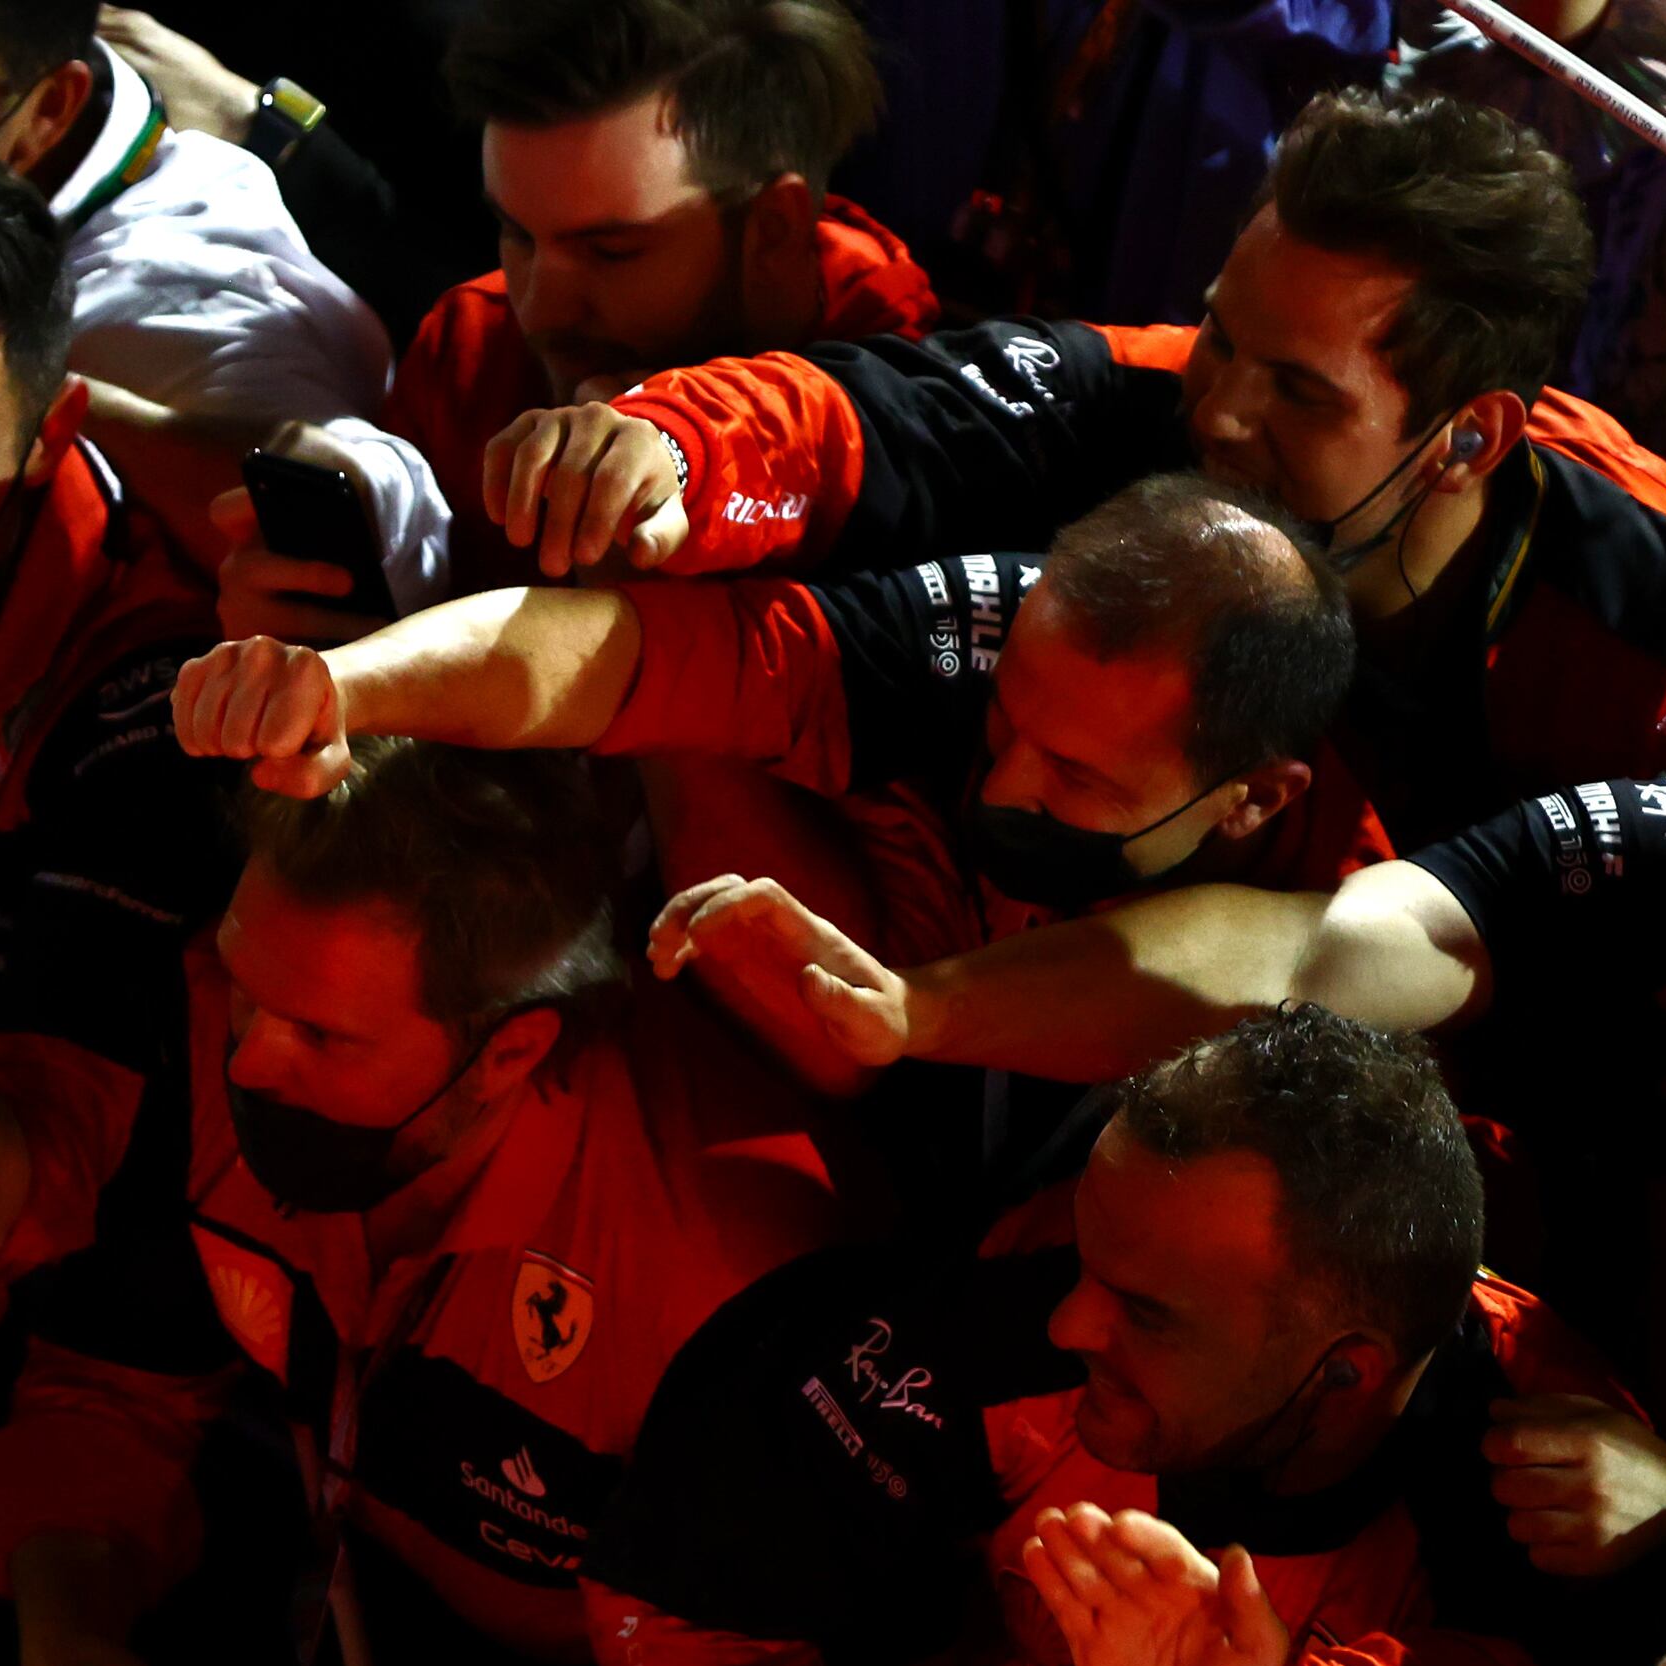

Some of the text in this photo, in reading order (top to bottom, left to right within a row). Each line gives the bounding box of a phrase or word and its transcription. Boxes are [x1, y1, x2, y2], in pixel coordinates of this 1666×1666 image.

[960, 553, 1005, 675] MAHLE
[843, 1315, 945, 1431] Ray-Ban
[459, 1458, 590, 1541] Santande
